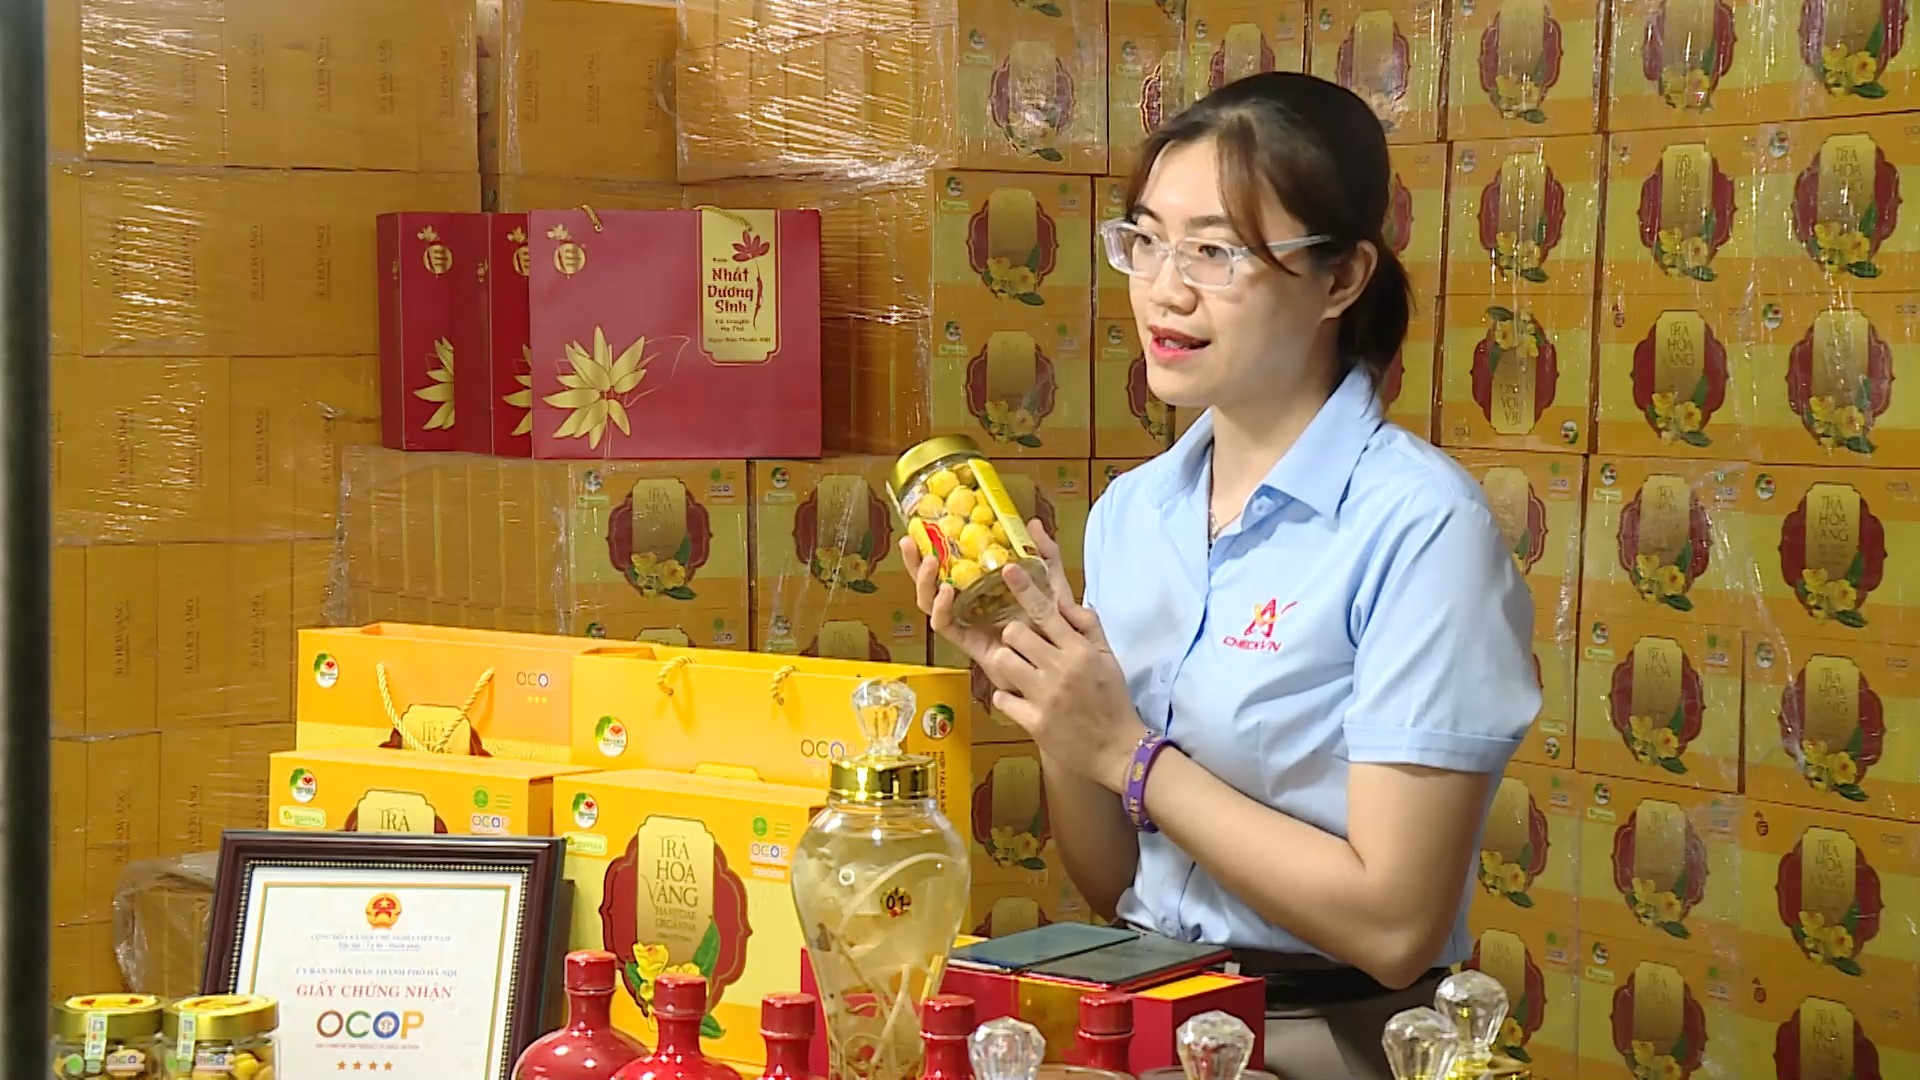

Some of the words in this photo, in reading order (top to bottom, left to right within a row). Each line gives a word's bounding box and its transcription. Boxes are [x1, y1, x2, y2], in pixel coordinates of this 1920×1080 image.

[1819, 511, 1848, 526] HOA
[656, 834, 690, 860] TRÀ
[656, 859, 697, 884] HOA
[640, 874, 699, 909] VÀNG
[296, 980, 337, 998] GIẤY
[340, 981, 401, 998] CHỨNG
[404, 982, 454, 1002] NHẬN
[316, 1010, 425, 1040] OCOP
